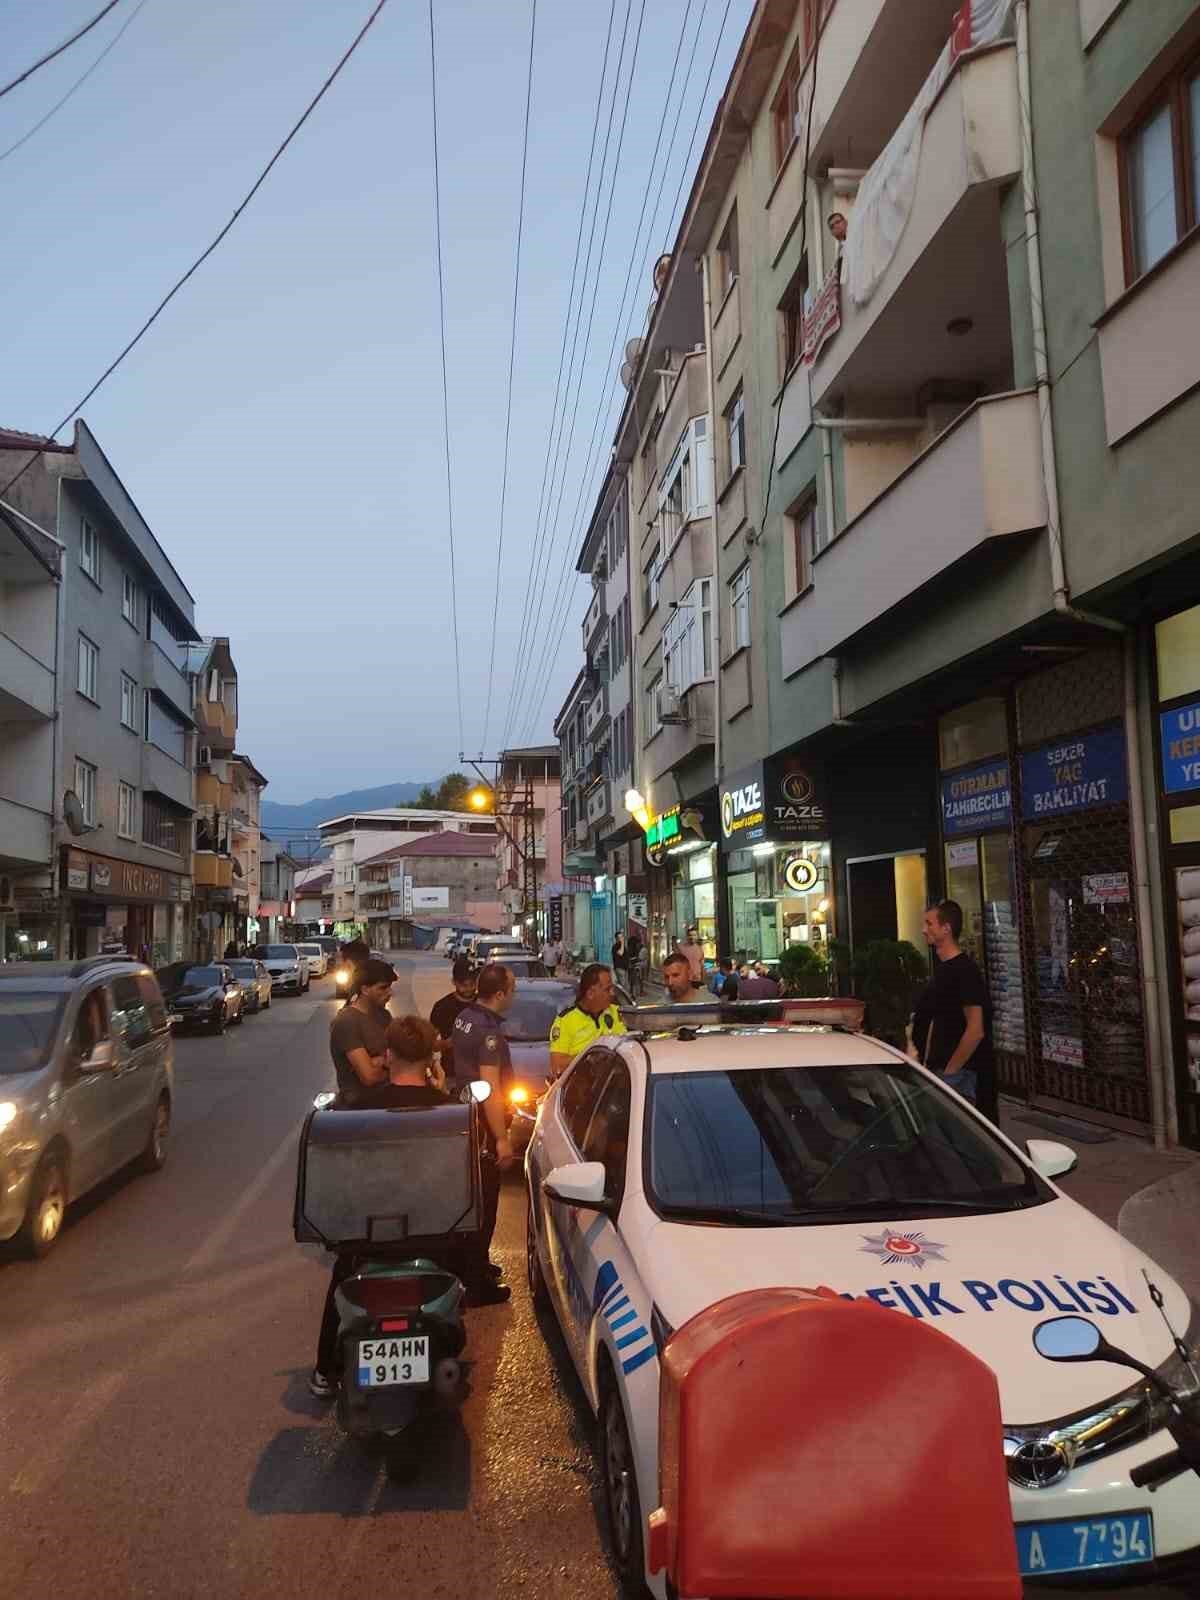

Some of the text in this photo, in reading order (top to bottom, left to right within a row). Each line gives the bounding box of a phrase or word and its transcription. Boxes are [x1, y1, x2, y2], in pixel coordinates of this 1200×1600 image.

[731, 782, 761, 816] TAZE
[774, 806, 824, 818] TAZE
[961, 1275, 1139, 1315] POLİSİ
[363, 1340, 425, 1360] 54AHN
[375, 1364, 412, 1382] 913
[1029, 1530, 1046, 1569] A
